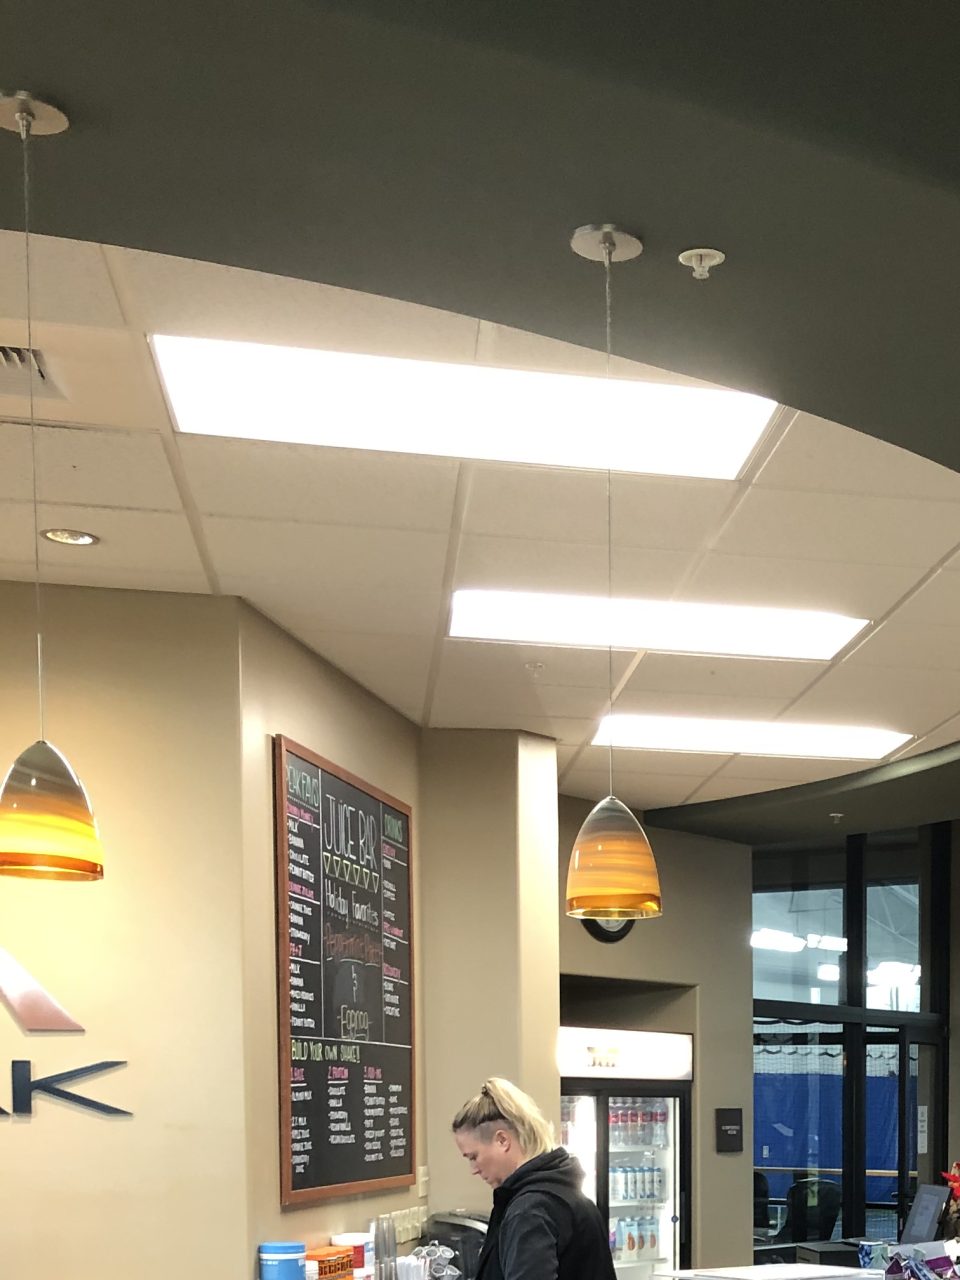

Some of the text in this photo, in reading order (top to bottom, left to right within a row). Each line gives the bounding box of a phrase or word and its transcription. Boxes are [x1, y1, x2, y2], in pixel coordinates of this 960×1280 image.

[324, 793, 378, 870] JUICE BAR
[325, 878, 349, 928] Holiday
[352, 890, 379, 927] Favorites
[341, 1004, 369, 1040] Eggnog
[291, 1040, 308, 1061] BUILD
[309, 1042, 323, 1062] YOUR
[325, 1045, 338, 1061] OWN
[0, 1060, 133, 1116] K
